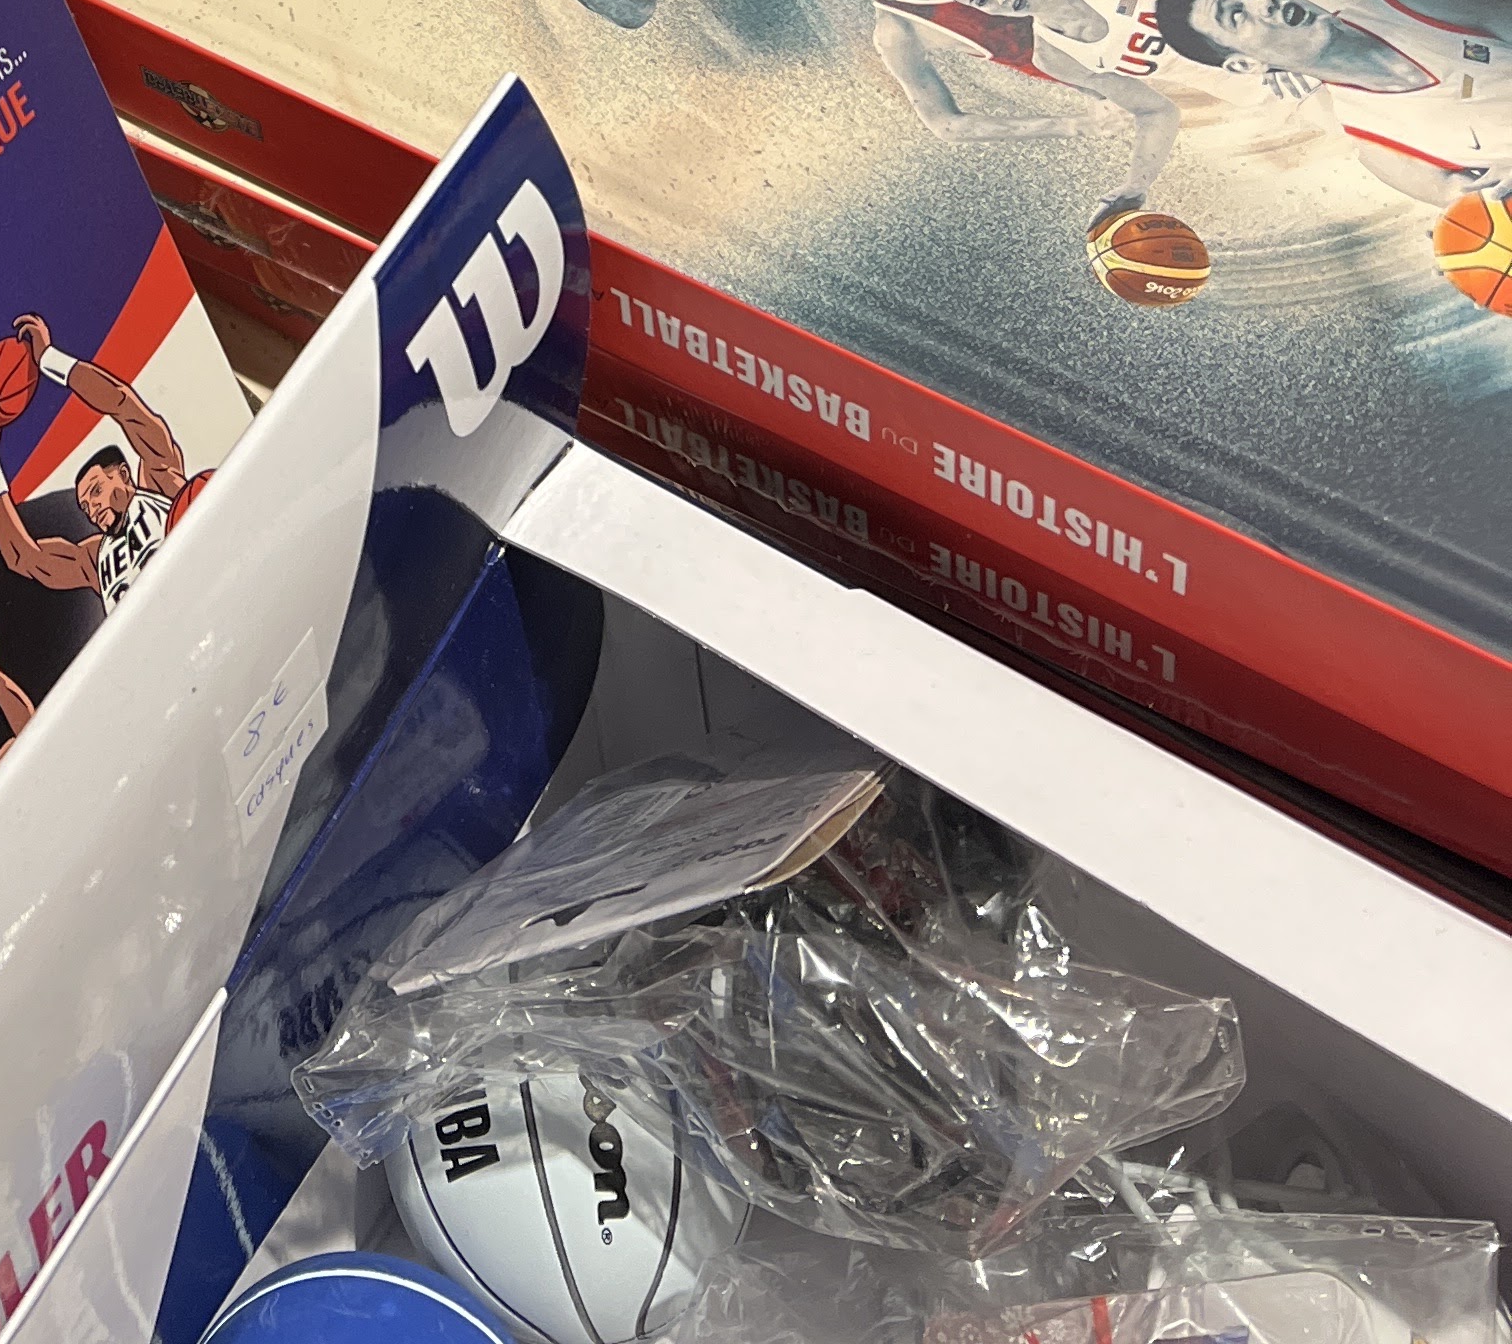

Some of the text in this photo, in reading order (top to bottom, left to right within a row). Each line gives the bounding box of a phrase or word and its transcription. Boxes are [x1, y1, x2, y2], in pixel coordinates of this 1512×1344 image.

[610, 286, 1189, 598] L'HISTOIRE DU BASKETBALL
[612, 395, 870, 541] BASKETBALL
[99, 508, 152, 591] HEAT
[928, 541, 1179, 683] L'HISTOIRE
[435, 1088, 502, 1184] BA
